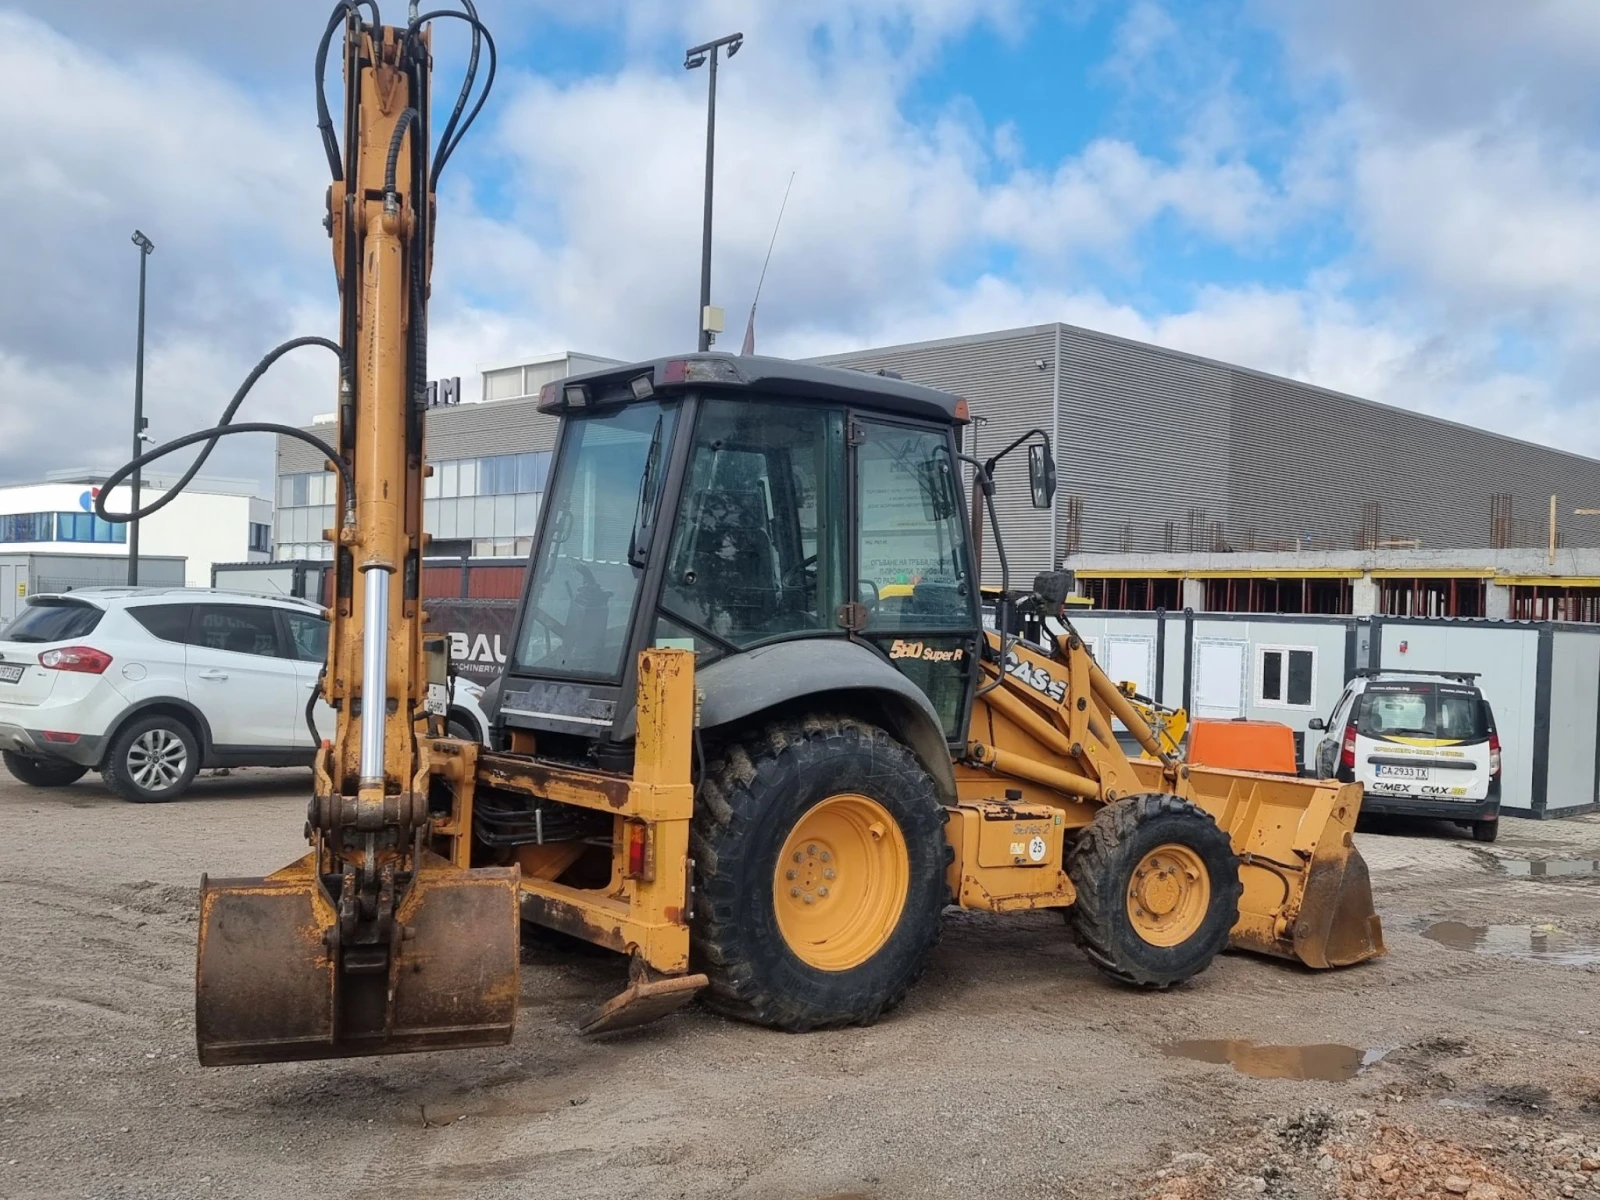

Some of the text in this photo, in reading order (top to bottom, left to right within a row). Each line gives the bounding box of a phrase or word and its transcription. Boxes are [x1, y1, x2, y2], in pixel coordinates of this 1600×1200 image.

[890, 640, 963, 663] 580 Super R
[451, 662, 496, 673] CHINERY
[1003, 651, 1068, 702] CASE
[1394, 766, 1414, 776] 2933
[1415, 768, 1427, 777] TX
[1013, 823, 1051, 836] Series 2
[1032, 841, 1043, 853] 25
